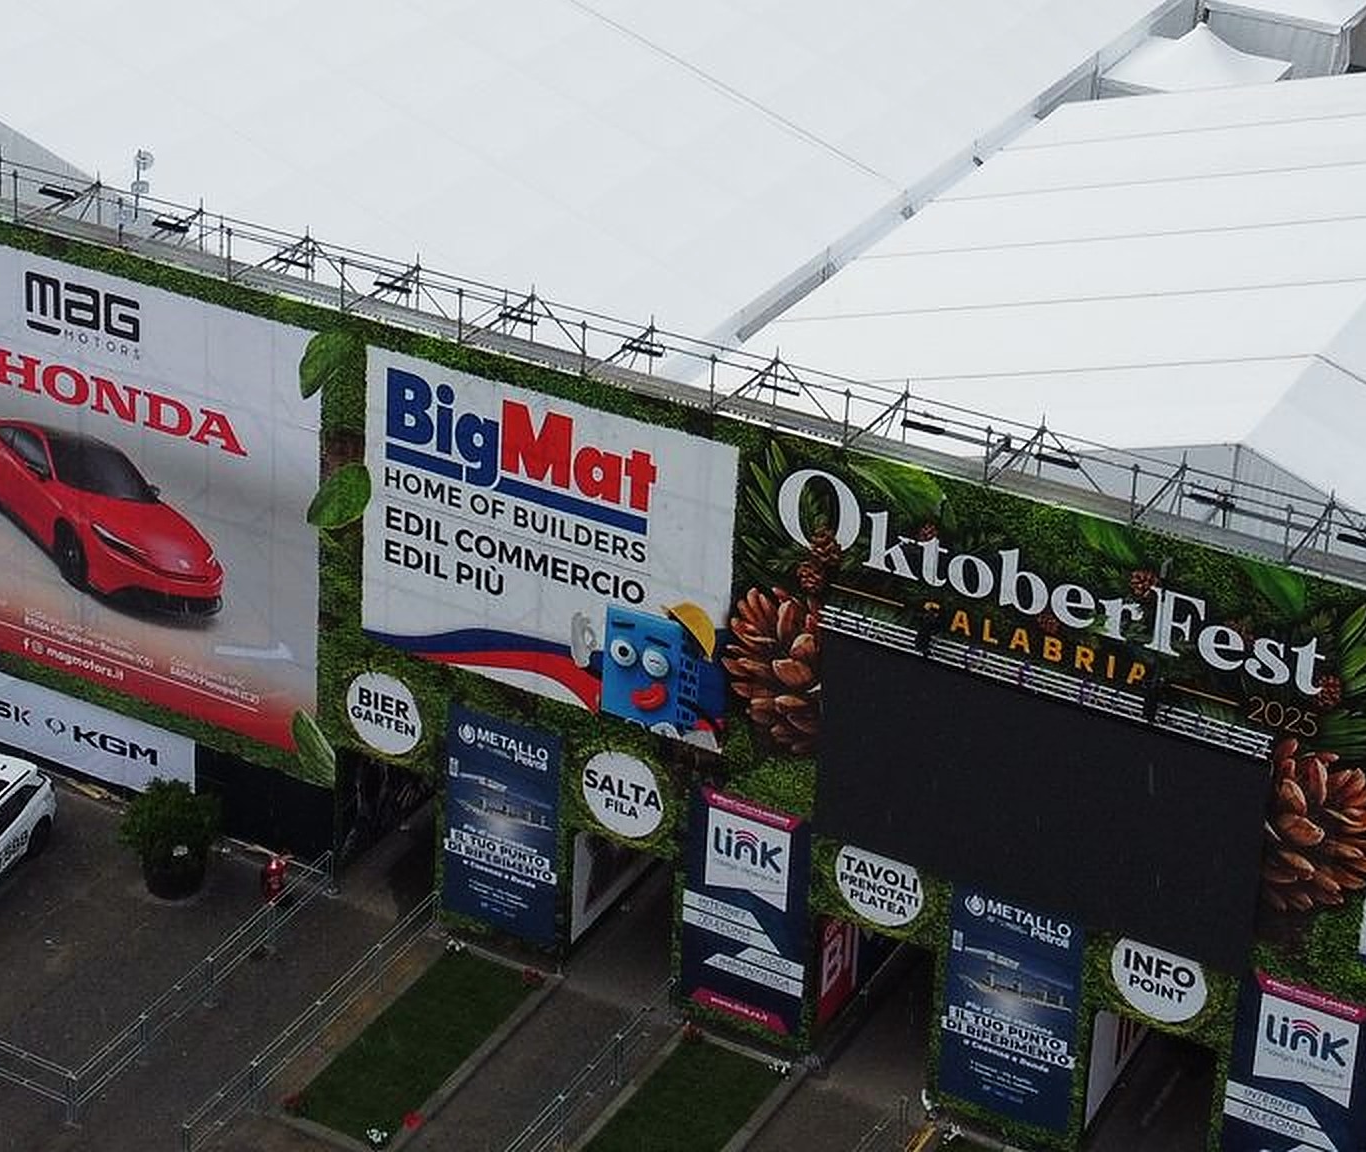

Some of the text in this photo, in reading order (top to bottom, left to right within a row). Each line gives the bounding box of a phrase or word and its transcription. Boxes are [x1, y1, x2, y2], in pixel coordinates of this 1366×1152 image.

[62, 329, 142, 361] MOTORS
[386, 367, 658, 513] BigMat
[384, 467, 647, 564] HOME OF BUILDERS
[384, 505, 646, 604] EDIL COMMERCIO
[384, 538, 505, 597] EDIL PIÙ
[923, 600, 1147, 686] ALABRIA
[46, 647, 125, 682] magmotors.it
[350, 705, 417, 738] GARTEN
[357, 686, 410, 721] BIER
[1248, 697, 1319, 738] 2025
[72, 724, 159, 766] KGM
[477, 727, 549, 762] METALLO
[583, 768, 663, 812] SALTA
[604, 797, 639, 820] FILA
[465, 844, 554, 882] RIFERIMENTO
[500, 843, 546, 869] PUNTO
[842, 854, 919, 892] TAVOLI
[839, 872, 920, 909] PRENOTATI
[850, 889, 908, 918] PLATEA
[986, 899, 1073, 939] METALLO
[1123, 949, 1196, 989] INFO
[1128, 974, 1187, 1003] POINT
[946, 1017, 962, 1032] DI
[965, 1022, 1071, 1066] RIFERIMENTO
[975, 1013, 1005, 1033] TUO
[1007, 1022, 1062, 1050] PUNTO
